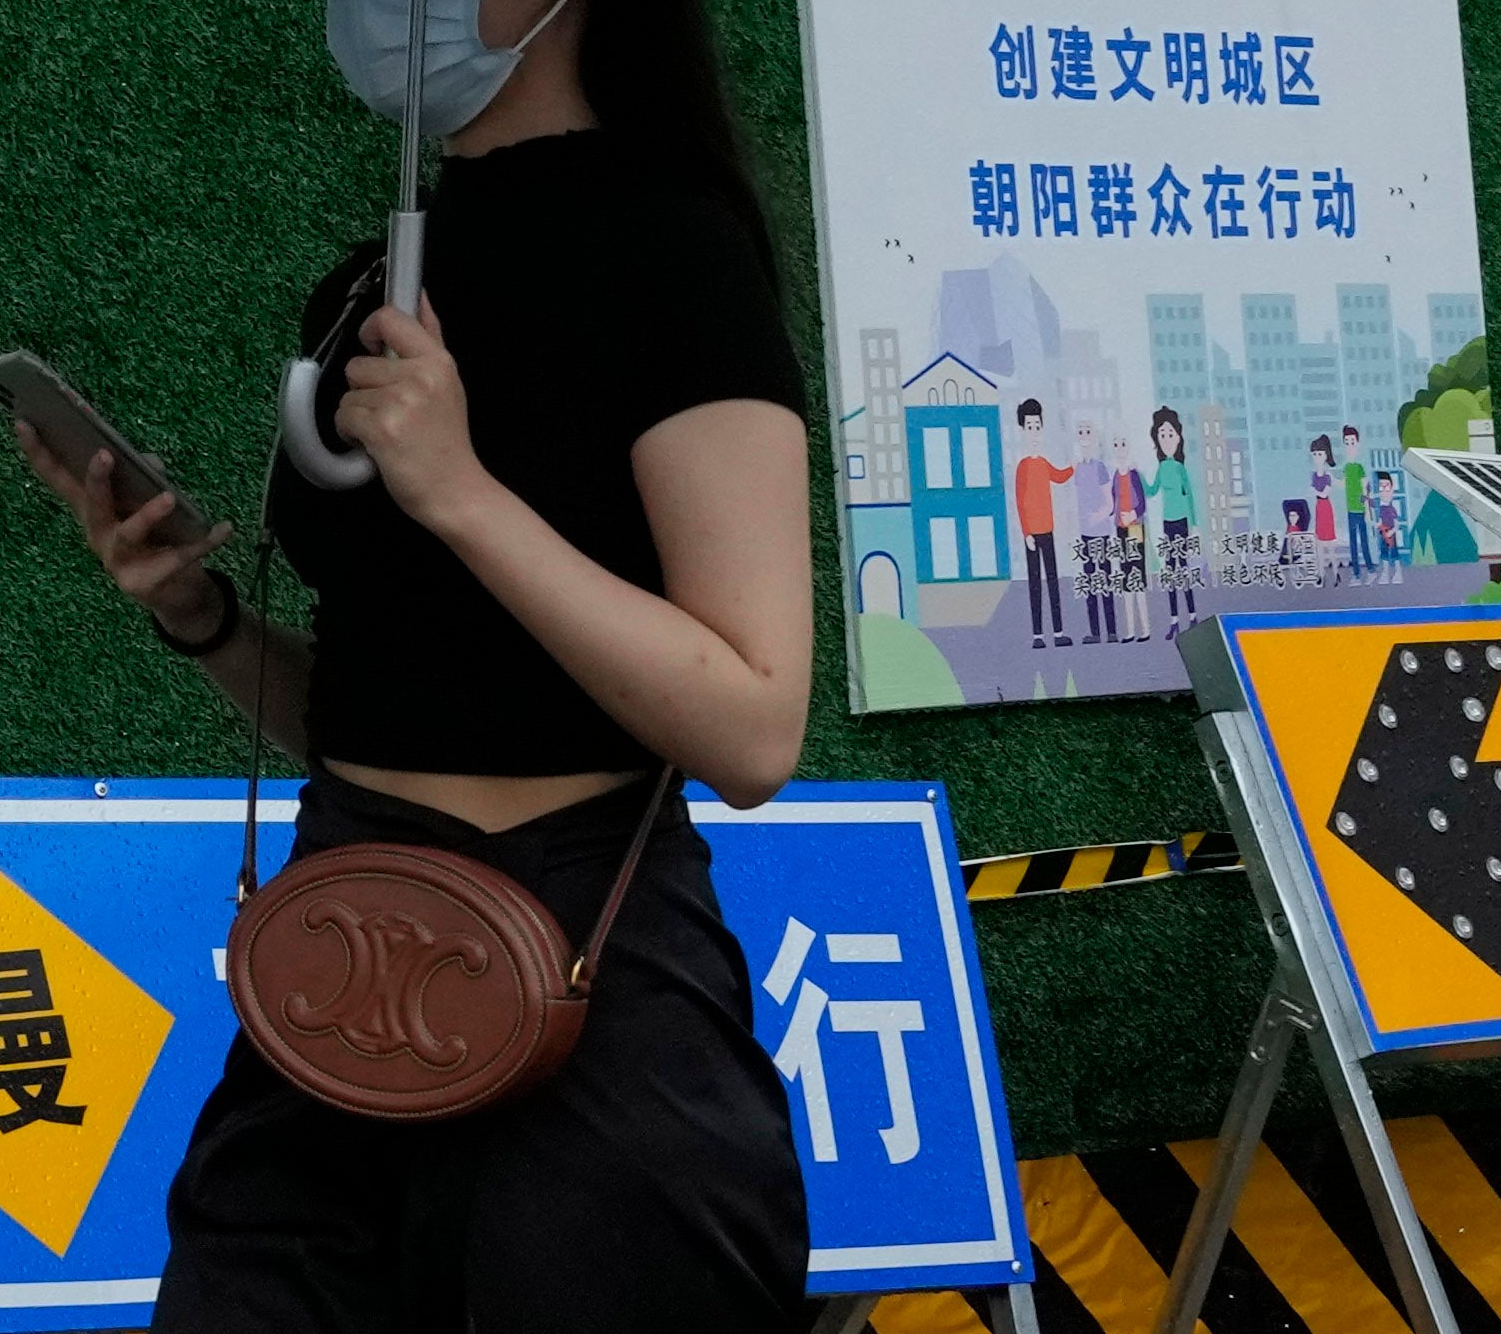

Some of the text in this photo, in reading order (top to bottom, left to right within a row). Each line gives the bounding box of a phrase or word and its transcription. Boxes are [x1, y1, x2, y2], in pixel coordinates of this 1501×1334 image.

[988, 22, 1321, 107] 创建文明城区
[968, 159, 1356, 240] 朝阳群众在行动
[762, 915, 925, 1165] 行
